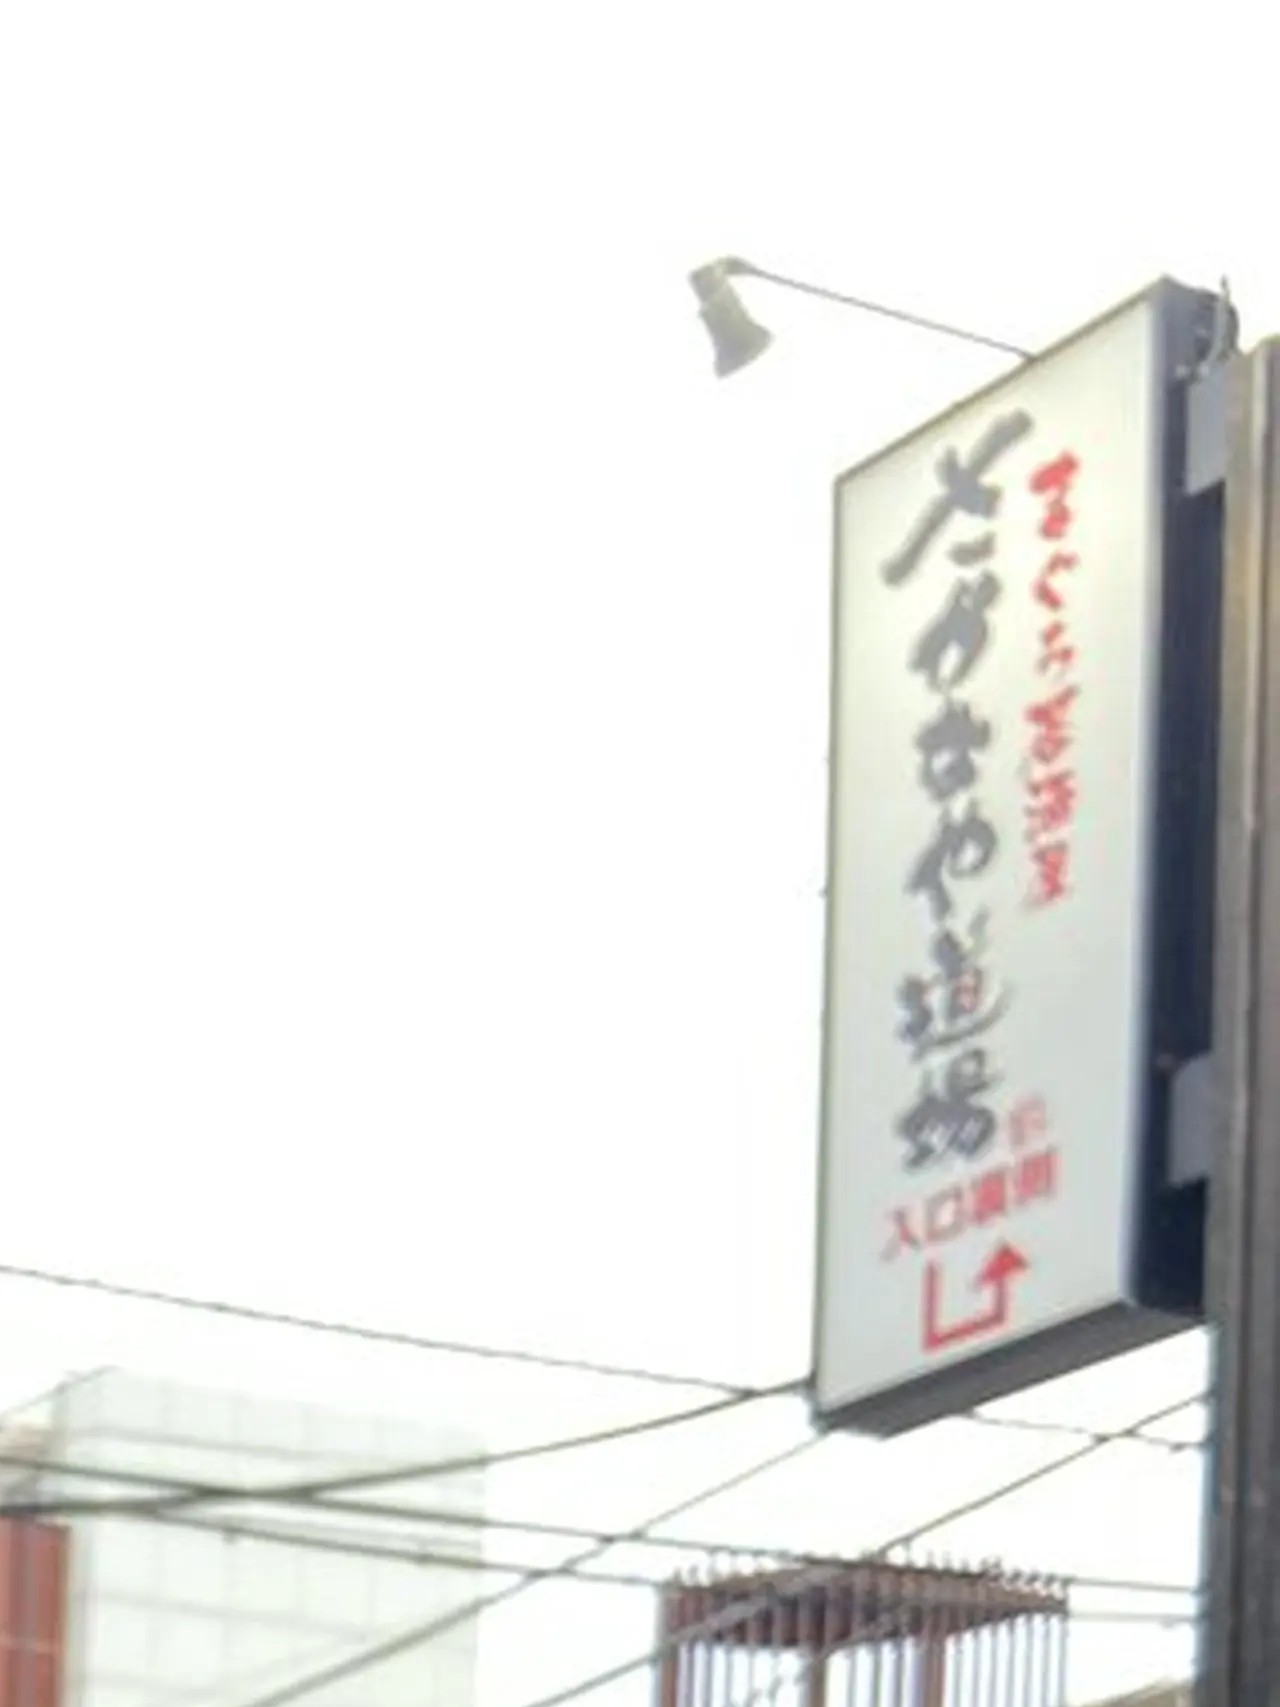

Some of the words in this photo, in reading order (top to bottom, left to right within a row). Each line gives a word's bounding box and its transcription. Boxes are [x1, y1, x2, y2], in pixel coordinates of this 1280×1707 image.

[880, 408, 1035, 1172] さかなや道場
